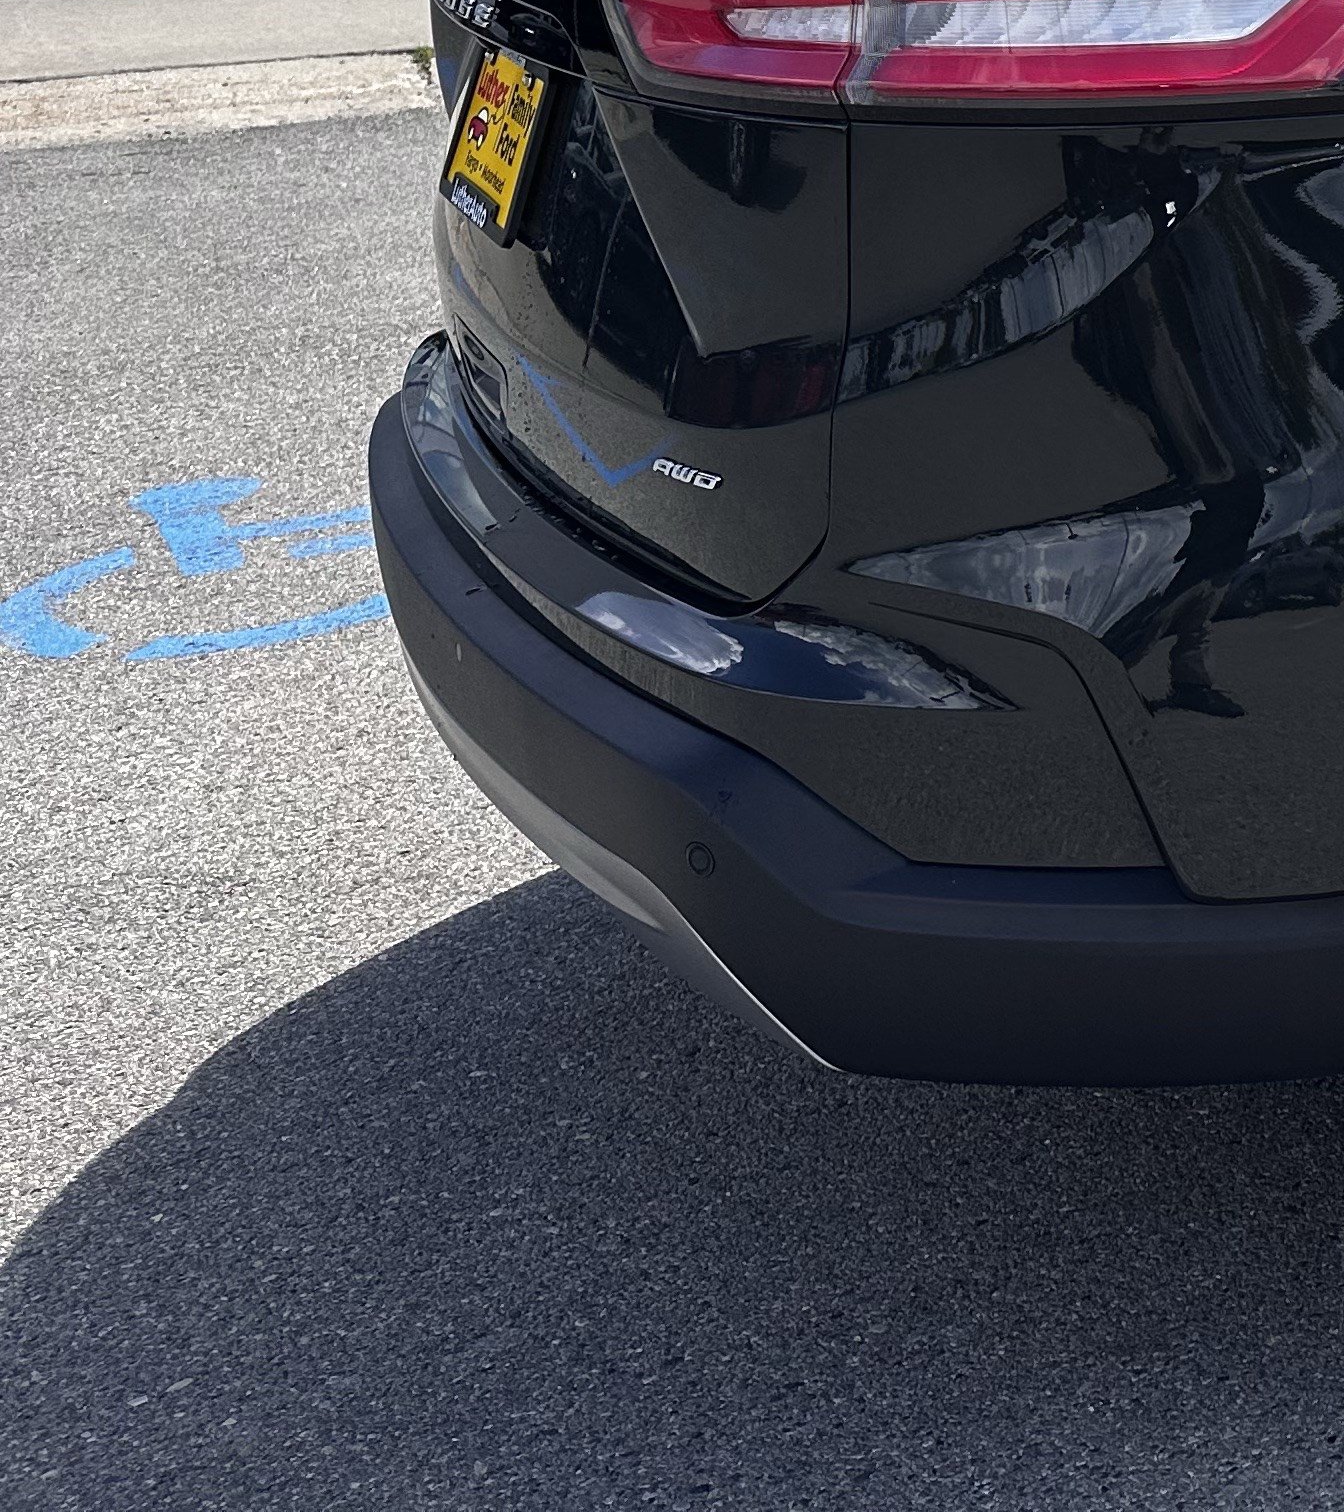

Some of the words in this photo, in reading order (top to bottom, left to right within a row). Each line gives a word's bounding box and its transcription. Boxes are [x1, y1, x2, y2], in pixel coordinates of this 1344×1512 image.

[477, 62, 511, 109] Luther
[507, 83, 537, 138] Family
[495, 122, 520, 166] Ford
[652, 458, 722, 490] AWD
